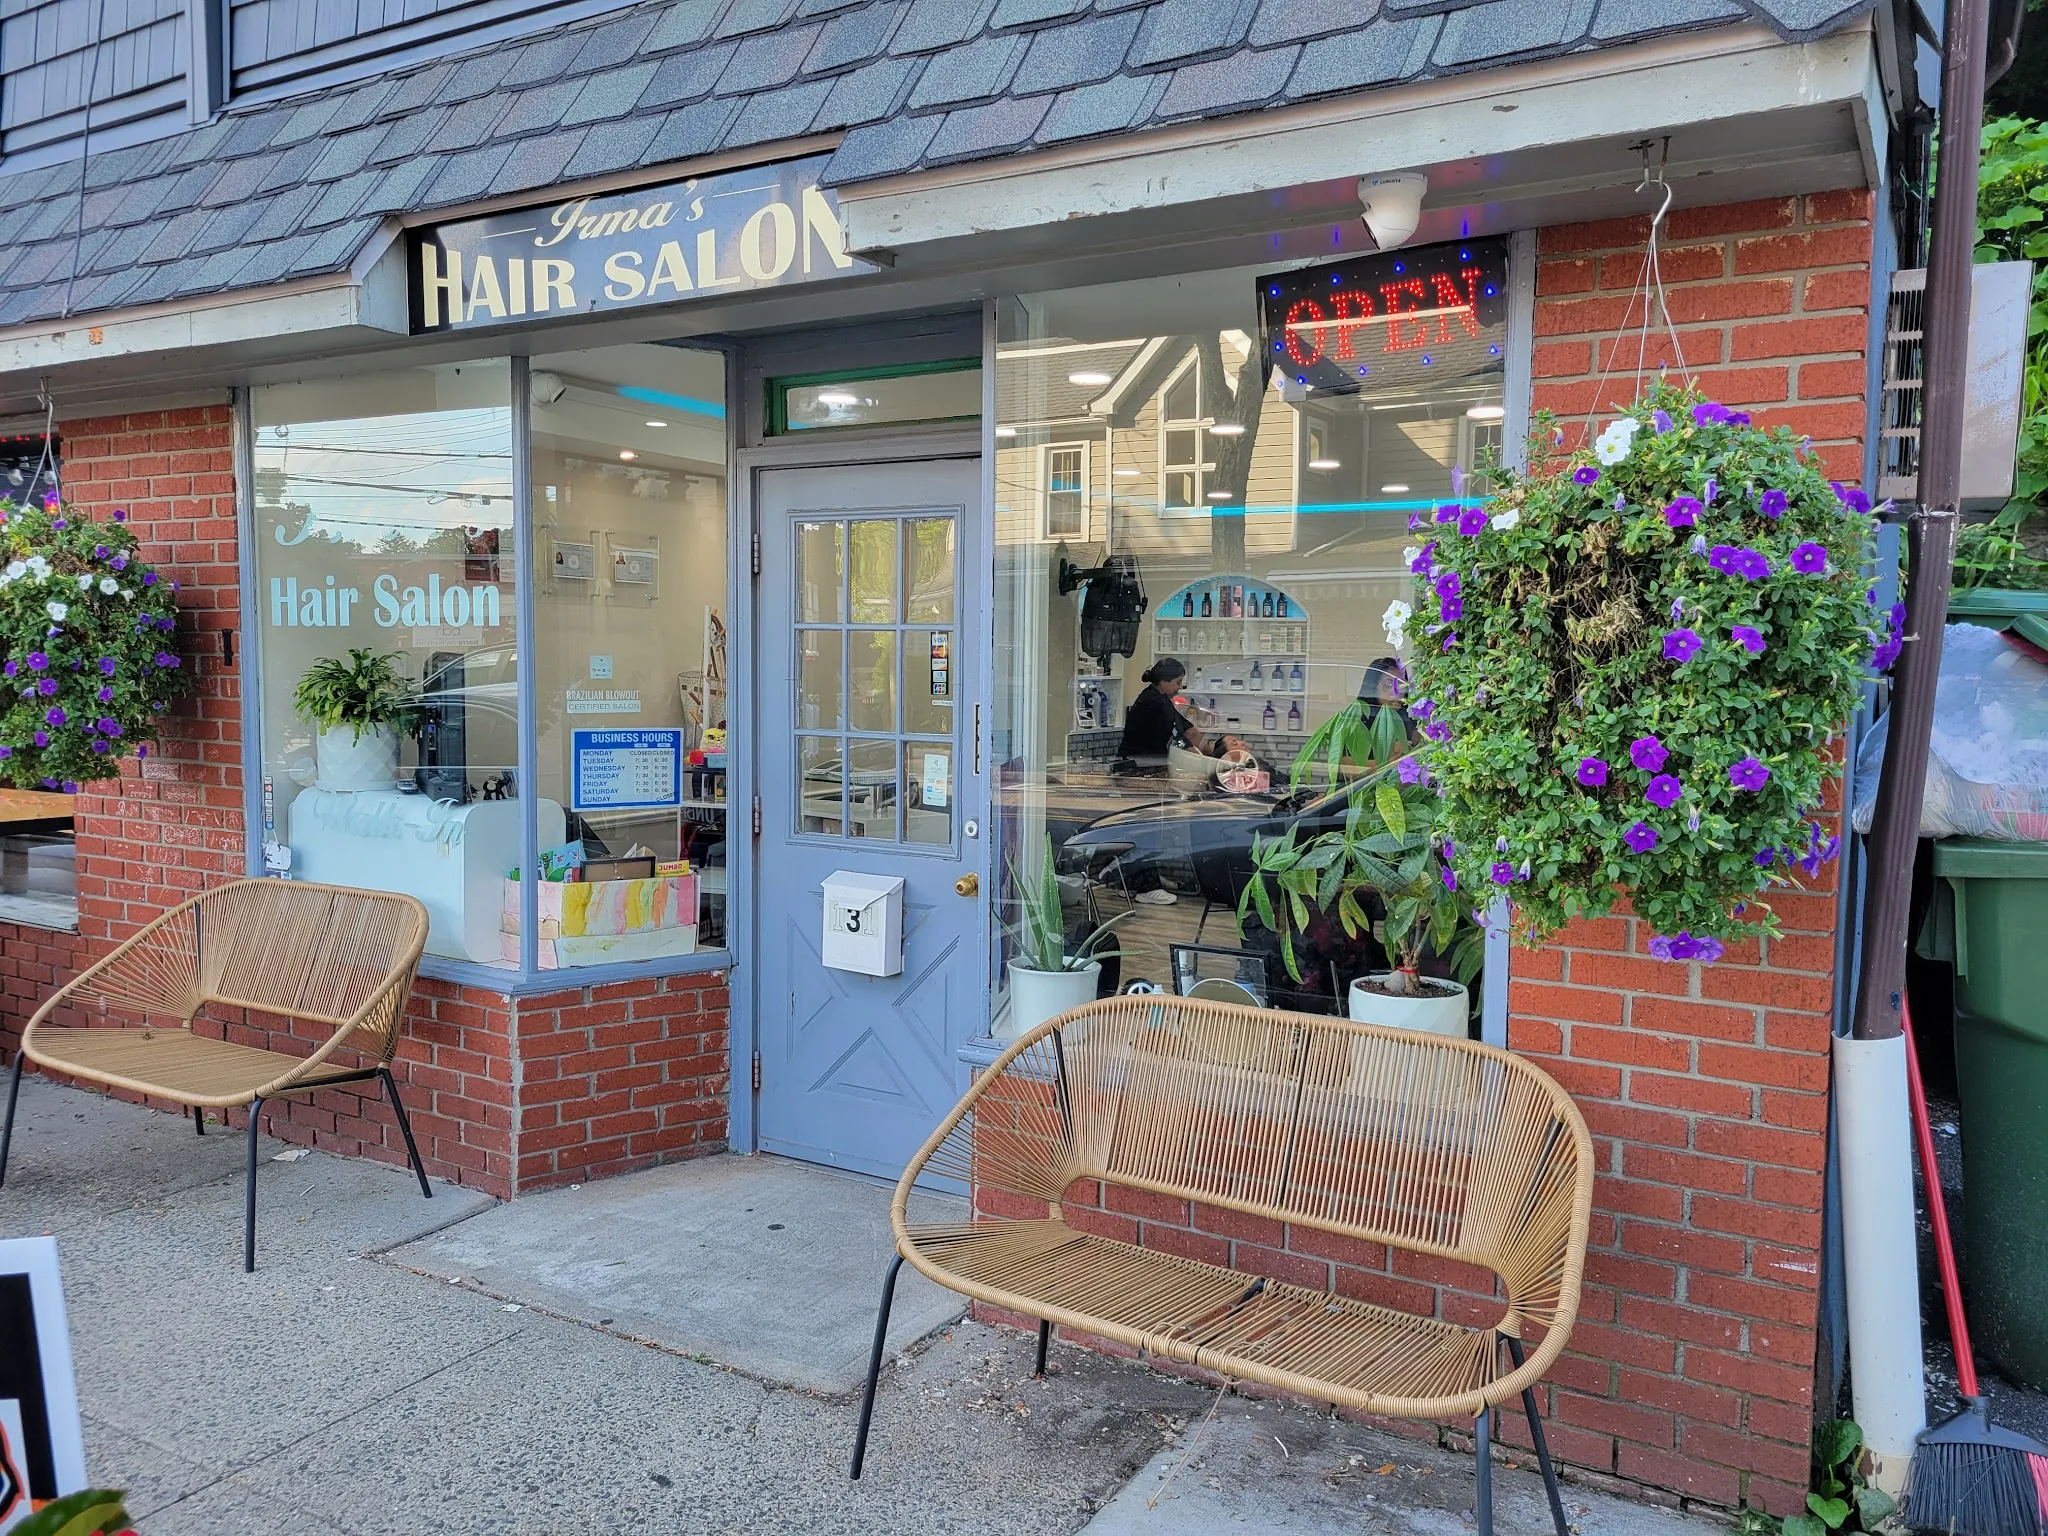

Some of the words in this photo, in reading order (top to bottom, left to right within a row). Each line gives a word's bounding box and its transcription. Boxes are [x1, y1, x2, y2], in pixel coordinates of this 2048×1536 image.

[535, 179, 704, 248] Irma's
[421, 242, 577, 328] HAIR
[604, 185, 853, 301] SALON
[1284, 267, 1481, 366] OPEN
[270, 576, 359, 627] Hair
[373, 573, 500, 628] Salon
[566, 690, 604, 700] BRAZILIAN
[606, 690, 640, 700] BLOWOUT
[568, 703, 611, 711] CERTIFIED
[591, 732, 639, 743] BUSINESS
[641, 732, 674, 743] HOURS
[658, 863, 683, 871] JUMBO
